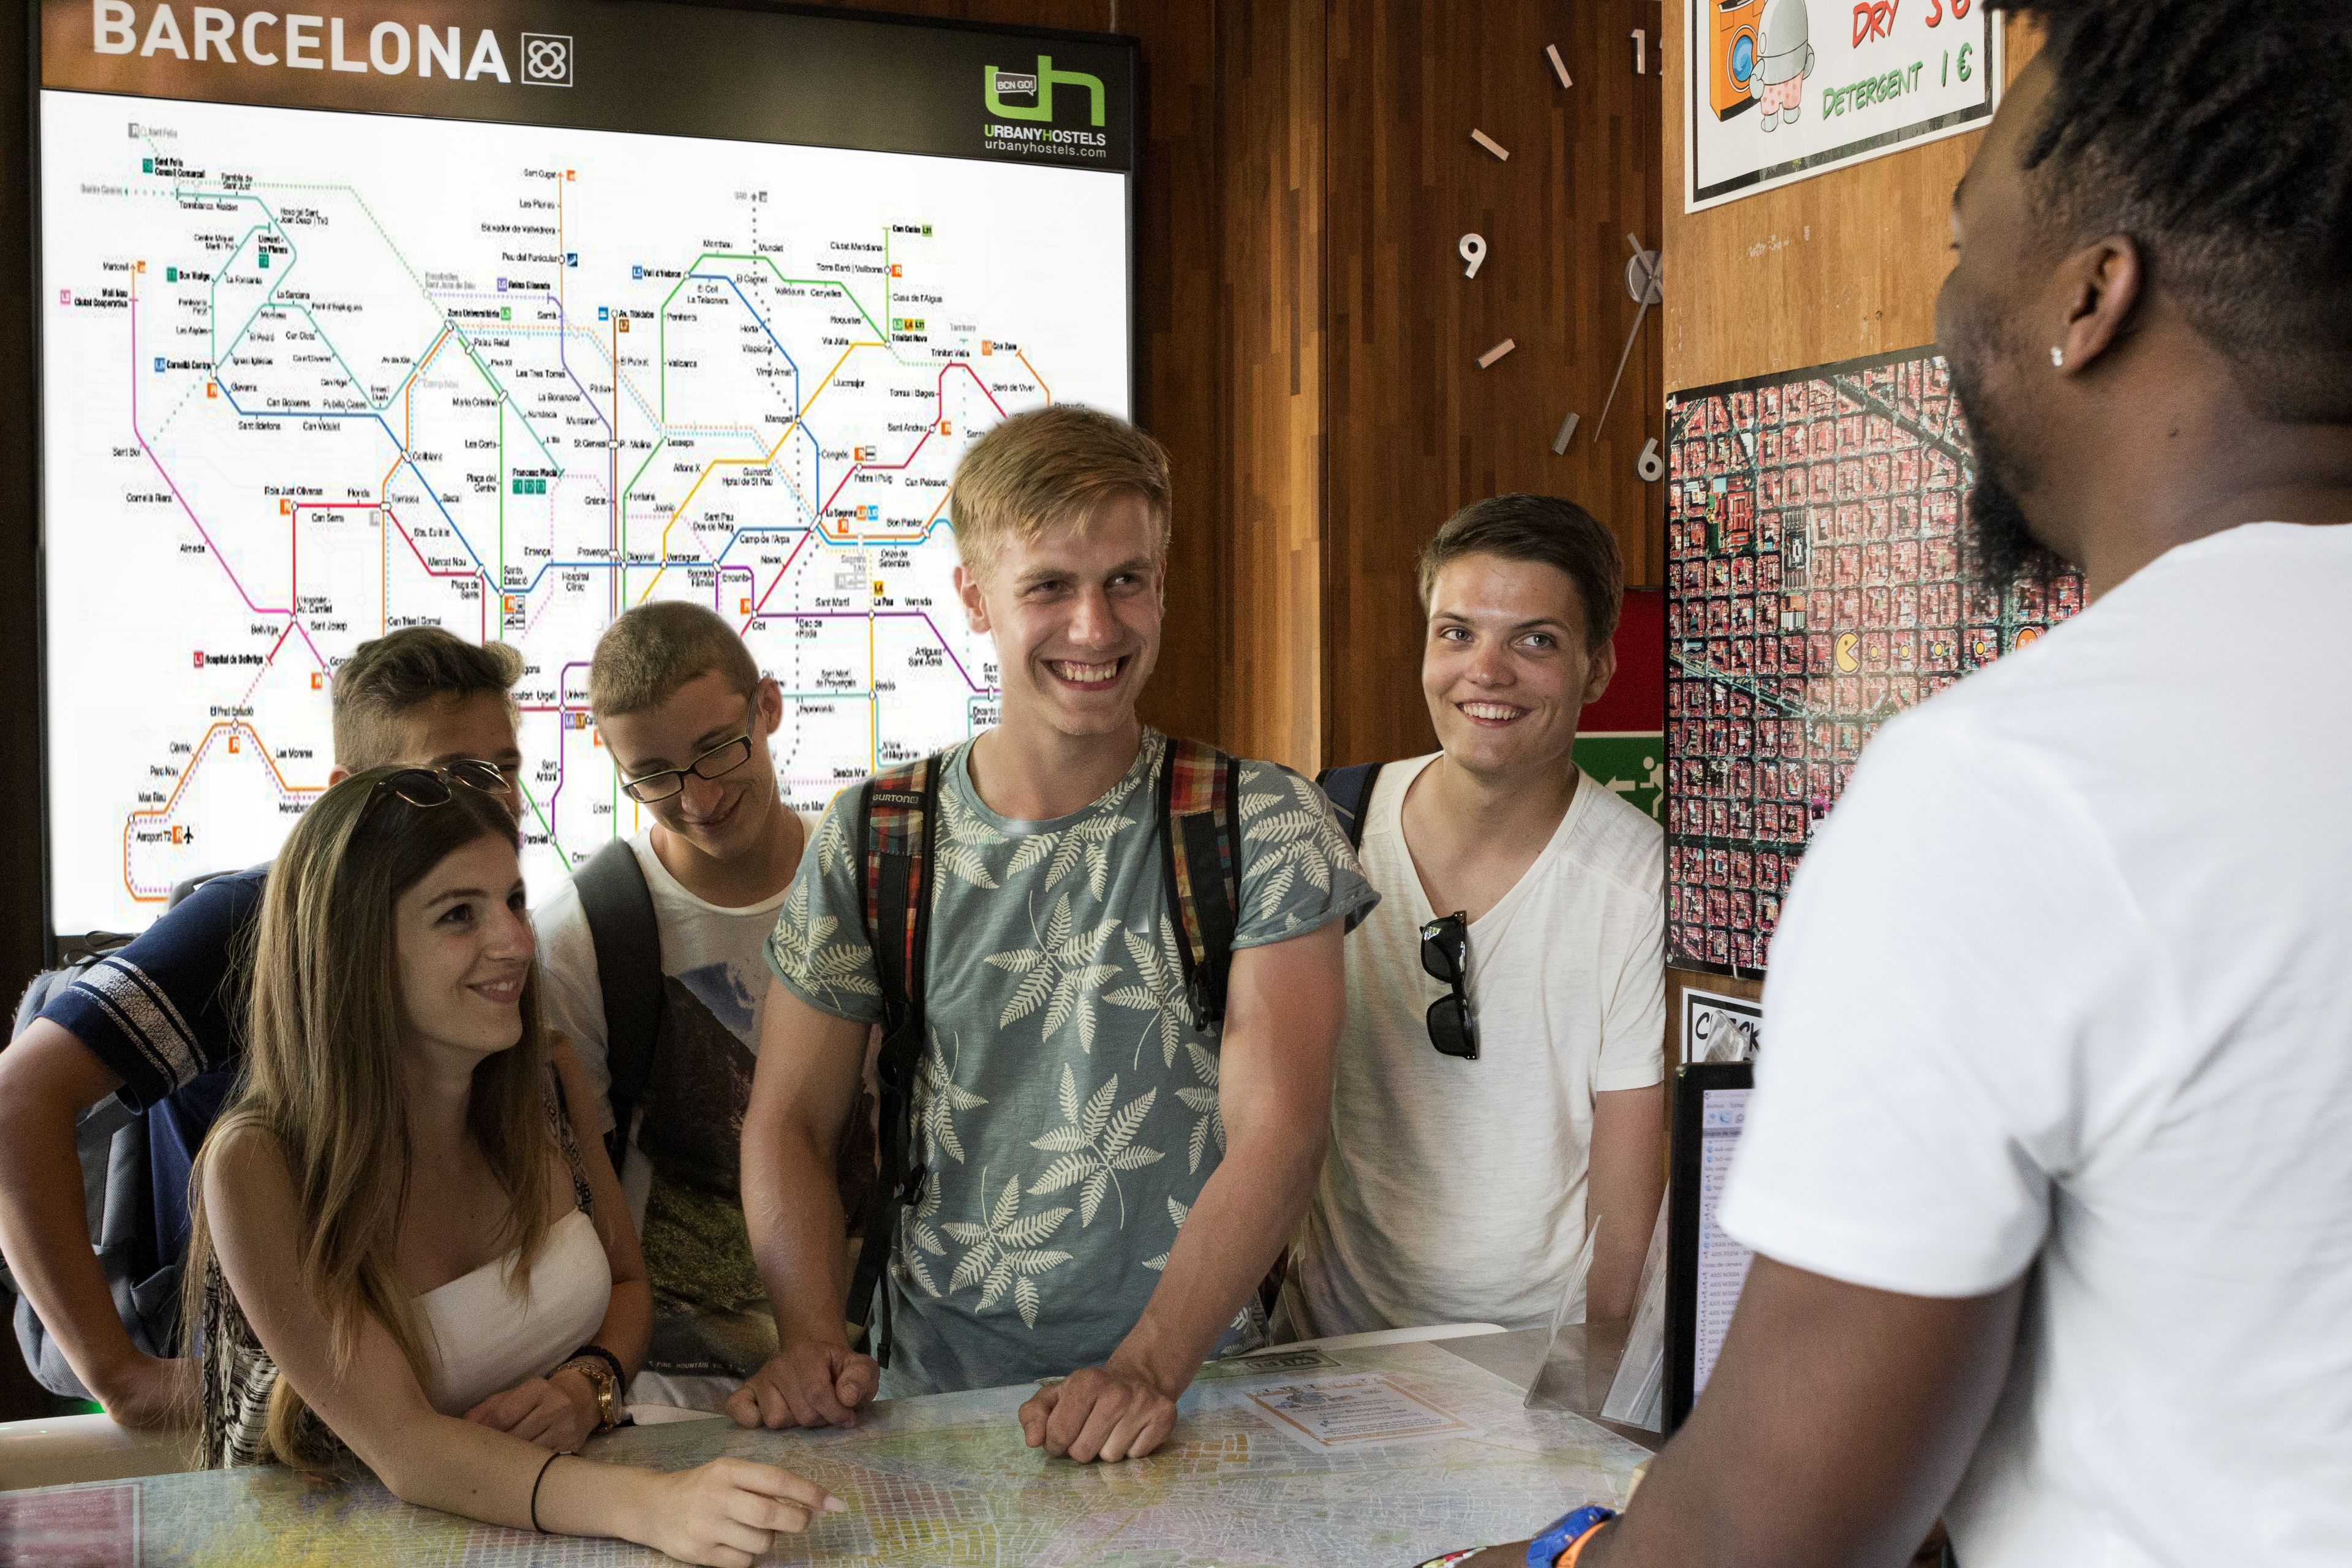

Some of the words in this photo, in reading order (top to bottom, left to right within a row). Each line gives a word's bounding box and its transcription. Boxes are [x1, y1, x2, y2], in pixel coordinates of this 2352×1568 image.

[94, 0, 511, 83] BARCELONA
[1852, 0, 1899, 49] DRY
[997, 81, 1016, 90] BCN
[1017, 80, 1033, 89] GO!
[1822, 61, 1923, 120] DETERGENT
[1956, 42, 1972, 82] €
[984, 124, 1106, 146] URBANYHOSTELS
[985, 139, 1106, 157] urbanyhostels.com
[1459, 233, 1487, 279] 9
[1635, 437, 1662, 482] 6
[873, 794, 910, 803] BURTON
